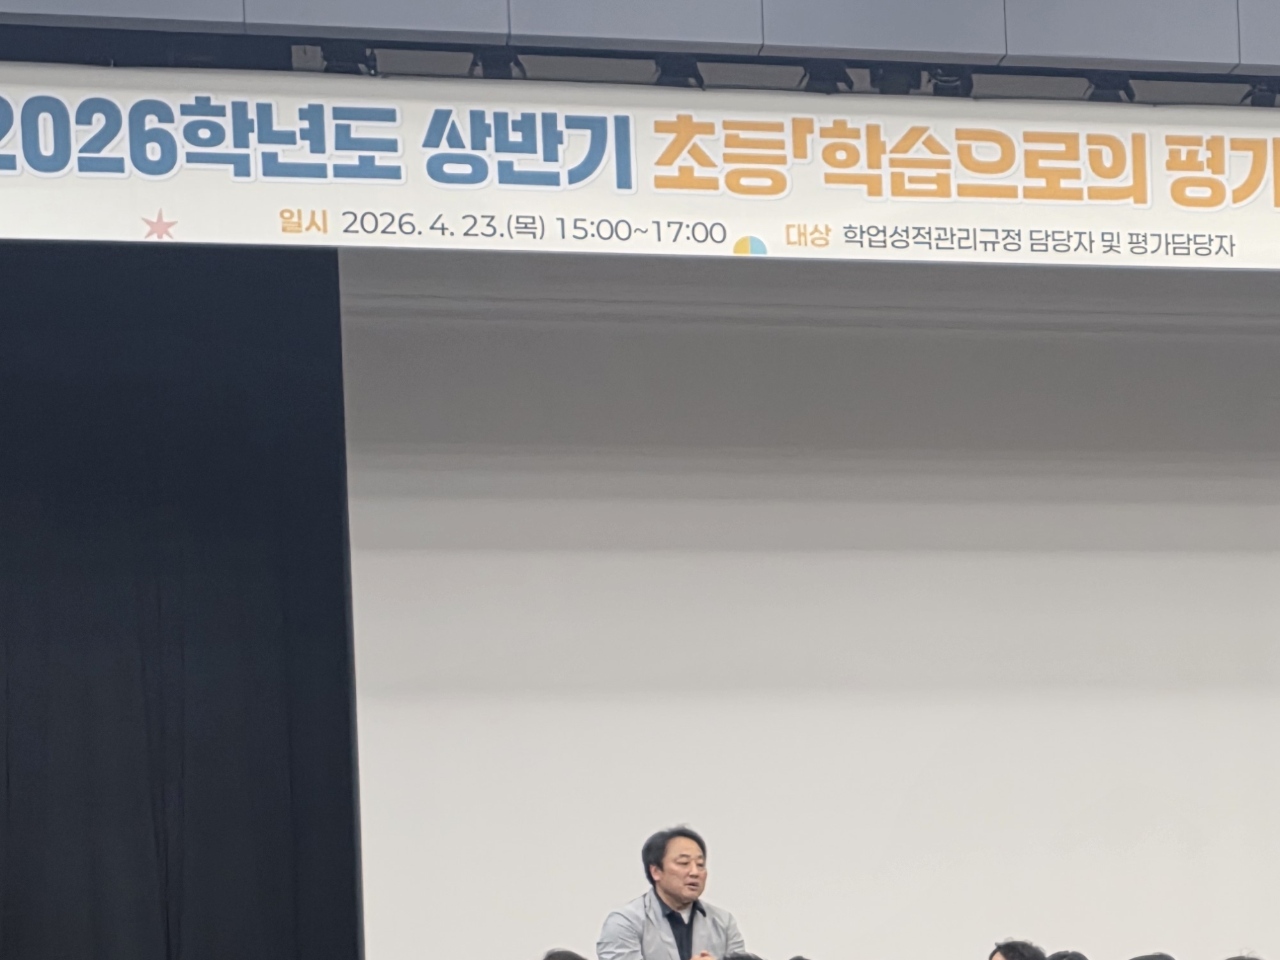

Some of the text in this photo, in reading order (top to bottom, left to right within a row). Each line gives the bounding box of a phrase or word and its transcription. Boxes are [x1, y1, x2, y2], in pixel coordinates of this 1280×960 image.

[422, 109, 633, 190] 상반기
[279, 208, 328, 235] 일시
[556, 217, 727, 244] 15:00~17:00
[786, 223, 1236, 257] 대상 학업성적관리규정 담당자 및 평가담당자
